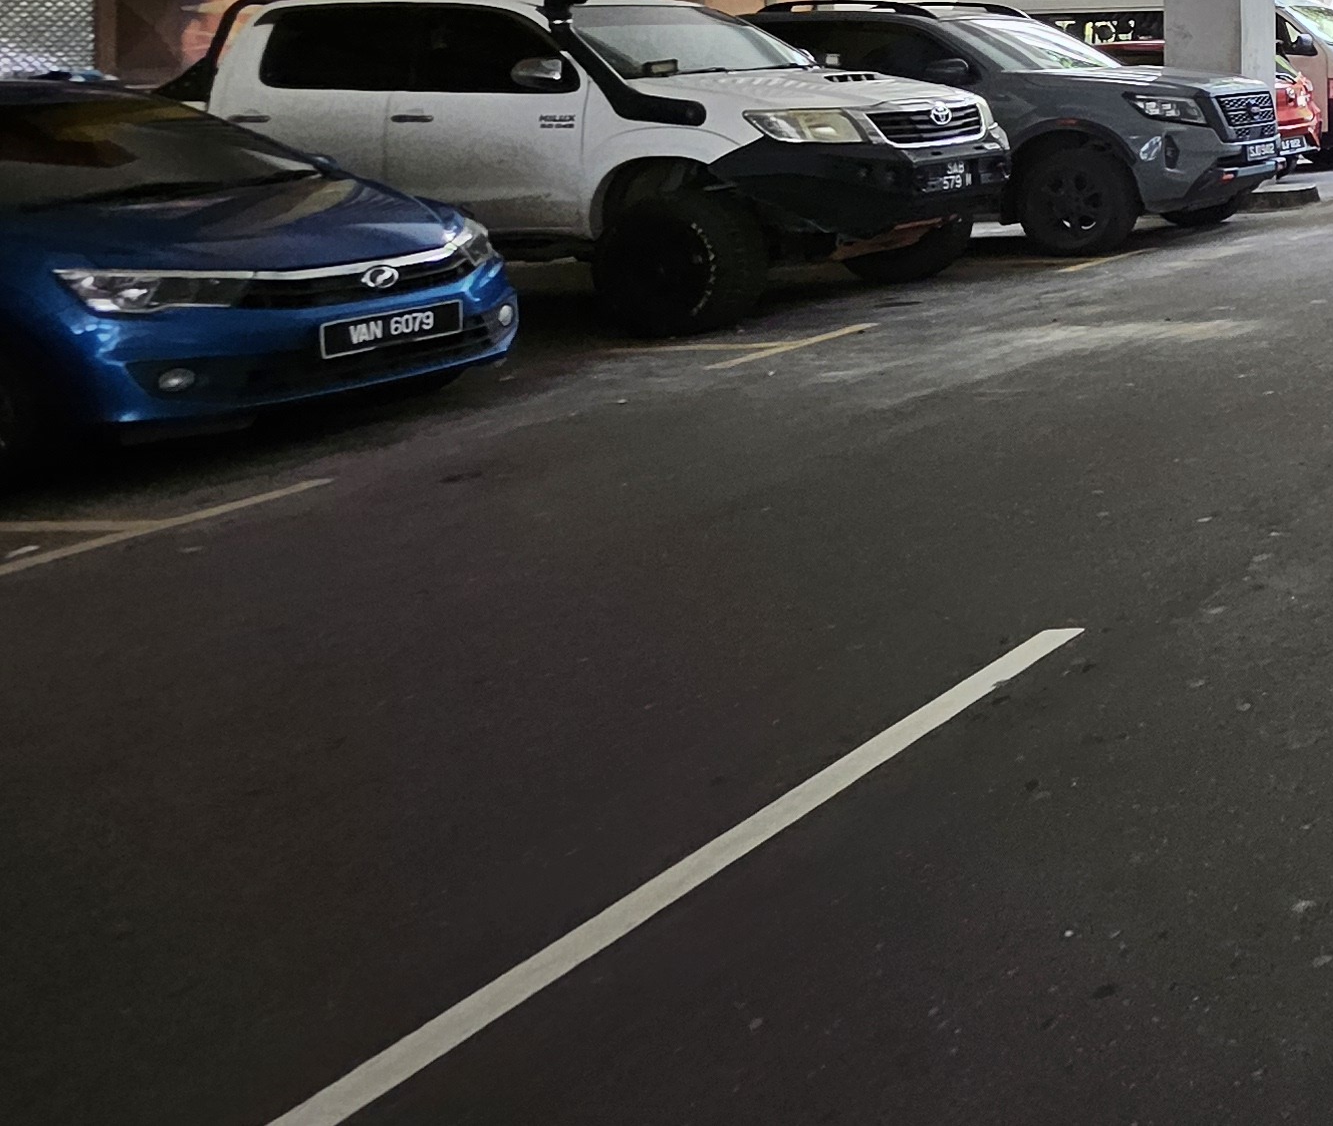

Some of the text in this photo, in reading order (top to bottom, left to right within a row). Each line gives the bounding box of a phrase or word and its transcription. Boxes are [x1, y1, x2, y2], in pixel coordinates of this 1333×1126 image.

[943, 174, 963, 190] 579
[349, 311, 434, 344] VAN 6079
